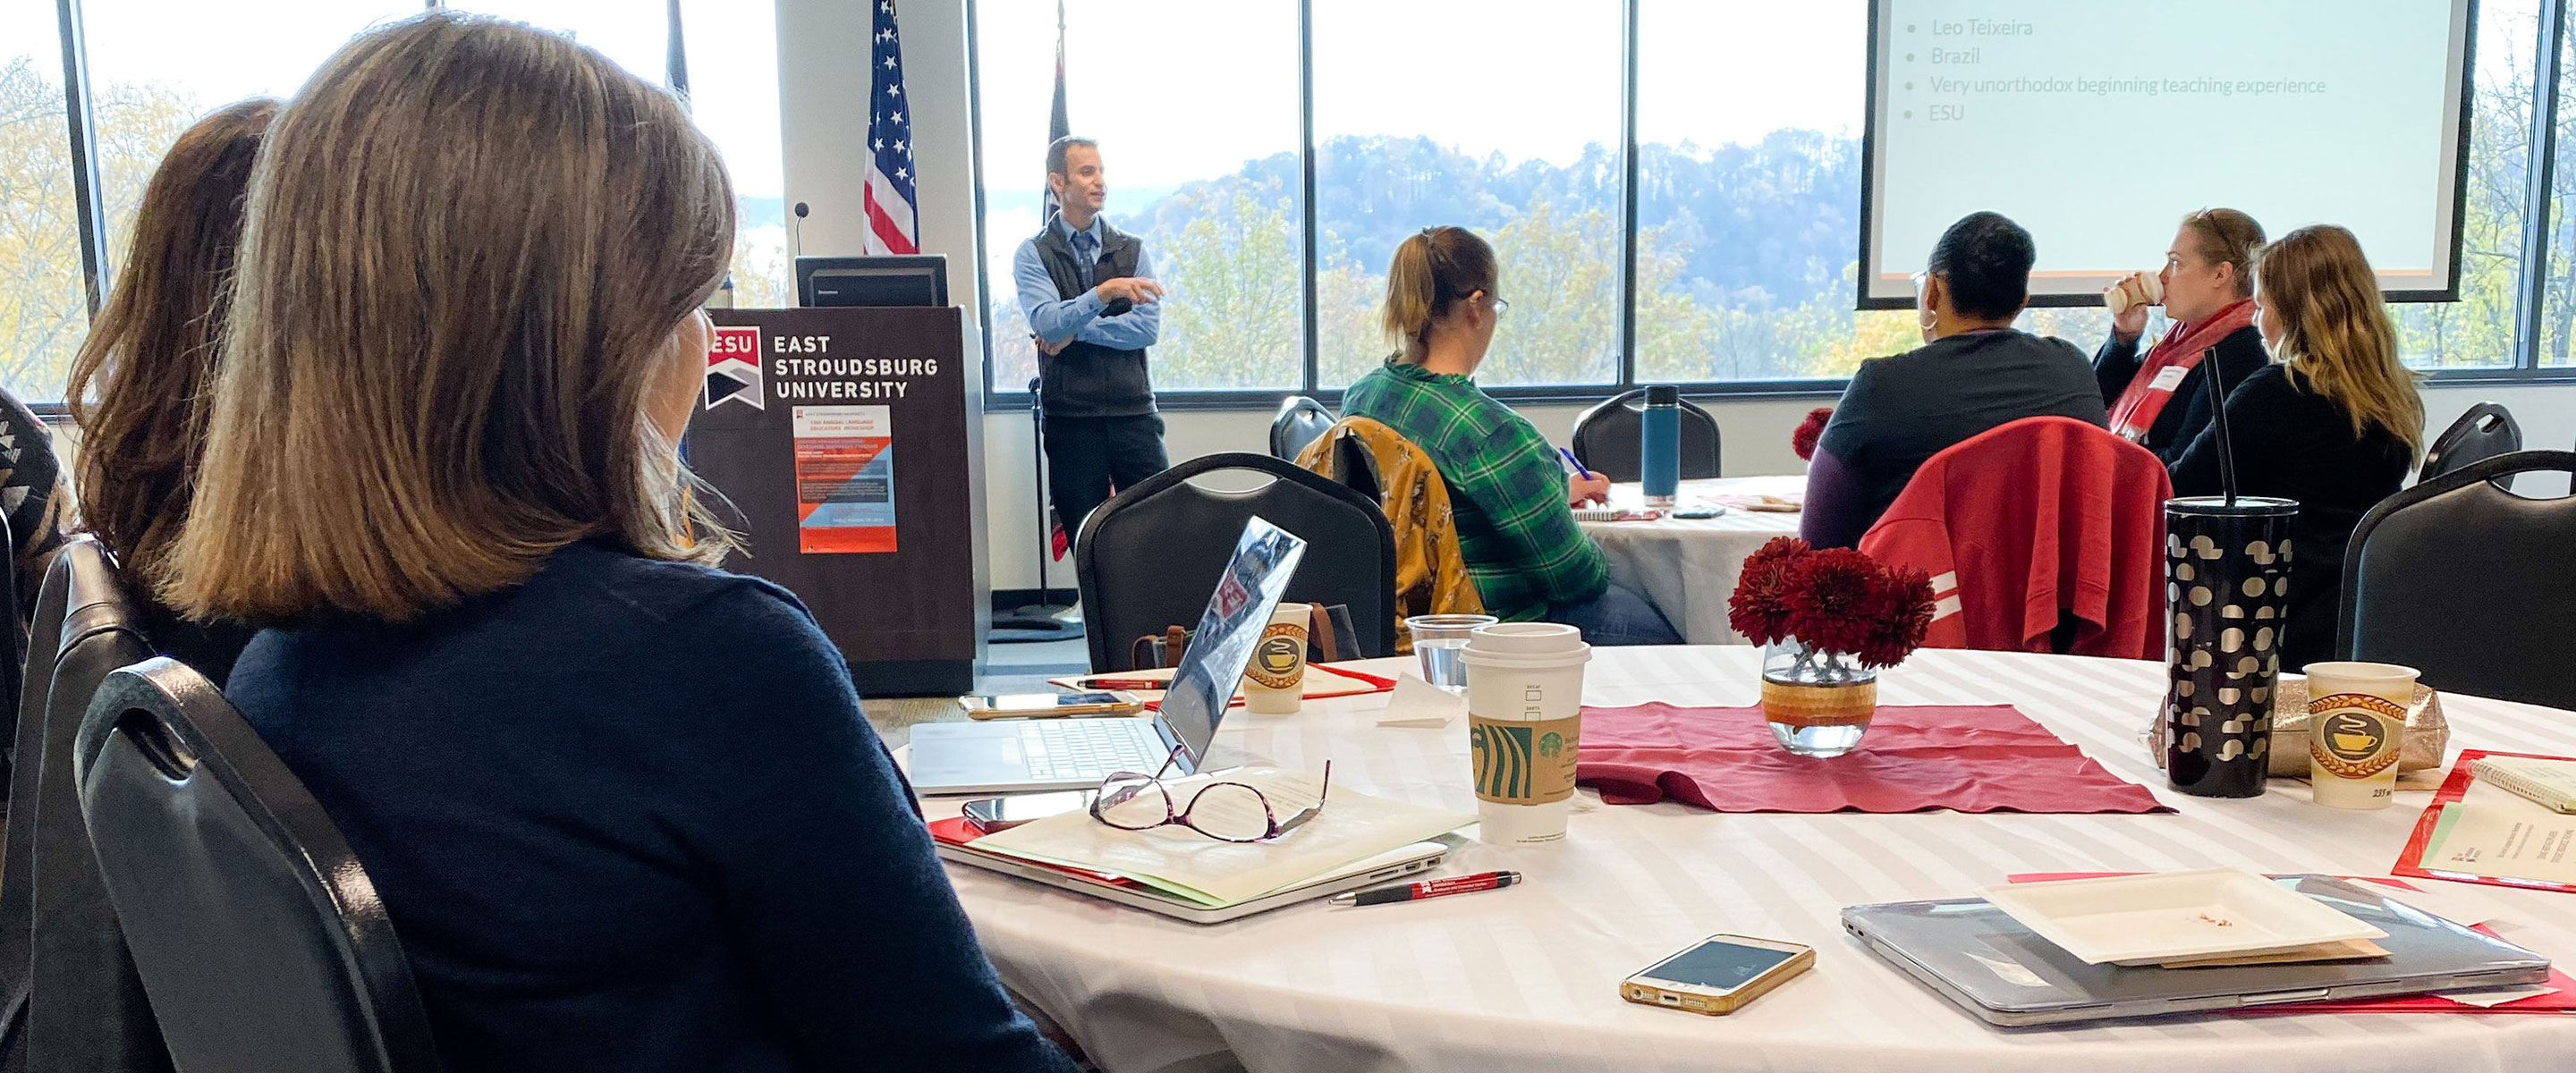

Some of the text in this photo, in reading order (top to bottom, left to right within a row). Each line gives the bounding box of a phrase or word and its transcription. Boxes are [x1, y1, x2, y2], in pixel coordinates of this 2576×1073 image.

[1933, 19, 2033, 36] Leo Teixeira
[1931, 47, 1981, 64] Brazil
[1930, 76, 2326, 96] Very unorthodox beginning teaching experience
[1929, 105, 1965, 121] ESU
[712, 335, 752, 353] ESU
[774, 336, 830, 353] EAST
[775, 359, 938, 376] STROUDSBURG
[776, 381, 908, 399] UNIVERSITY
